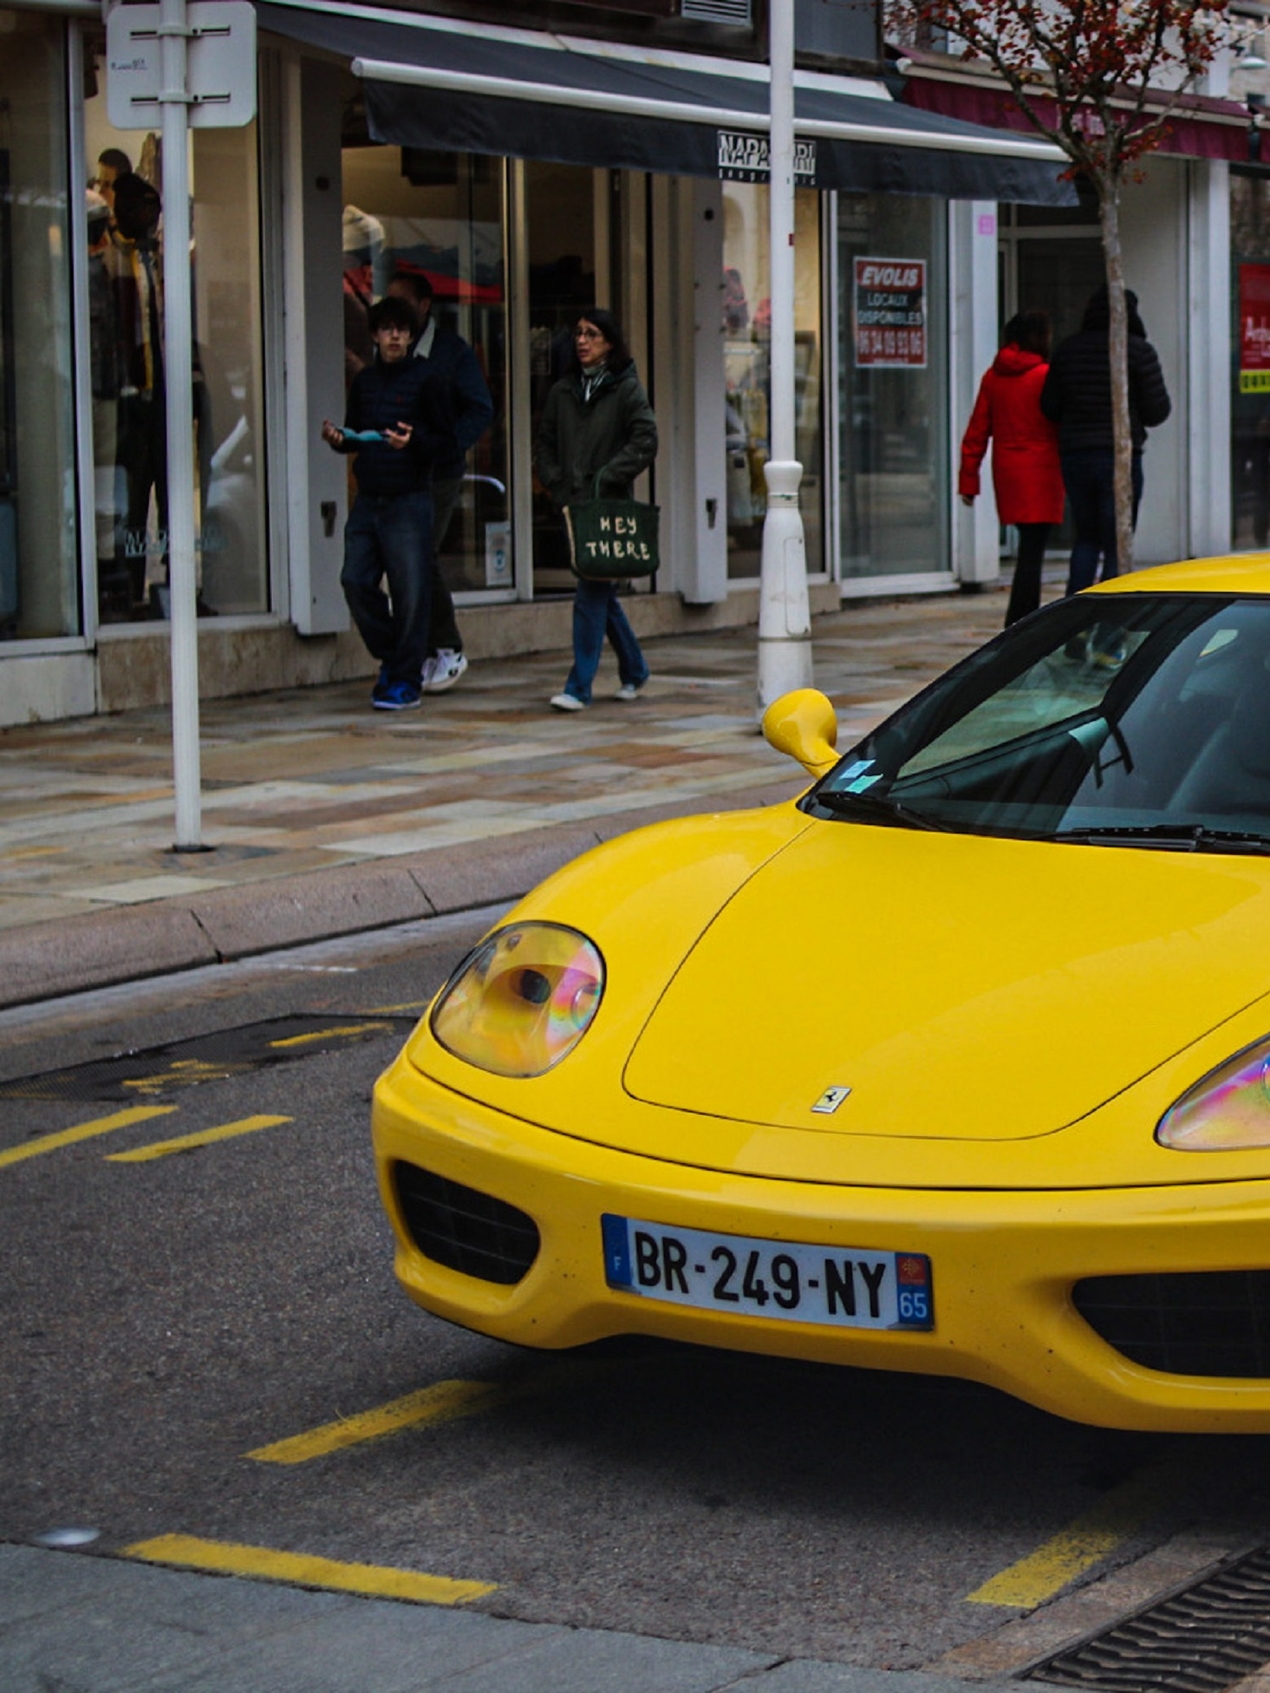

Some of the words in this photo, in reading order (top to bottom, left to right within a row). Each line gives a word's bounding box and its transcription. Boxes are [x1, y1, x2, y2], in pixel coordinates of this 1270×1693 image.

[861, 266, 918, 287] EVOLIS
[600, 516, 637, 535] HEY
[585, 541, 651, 560] THERE
[634, 1231, 887, 1318] BR-249-NY
[900, 1292, 927, 1318] 65
